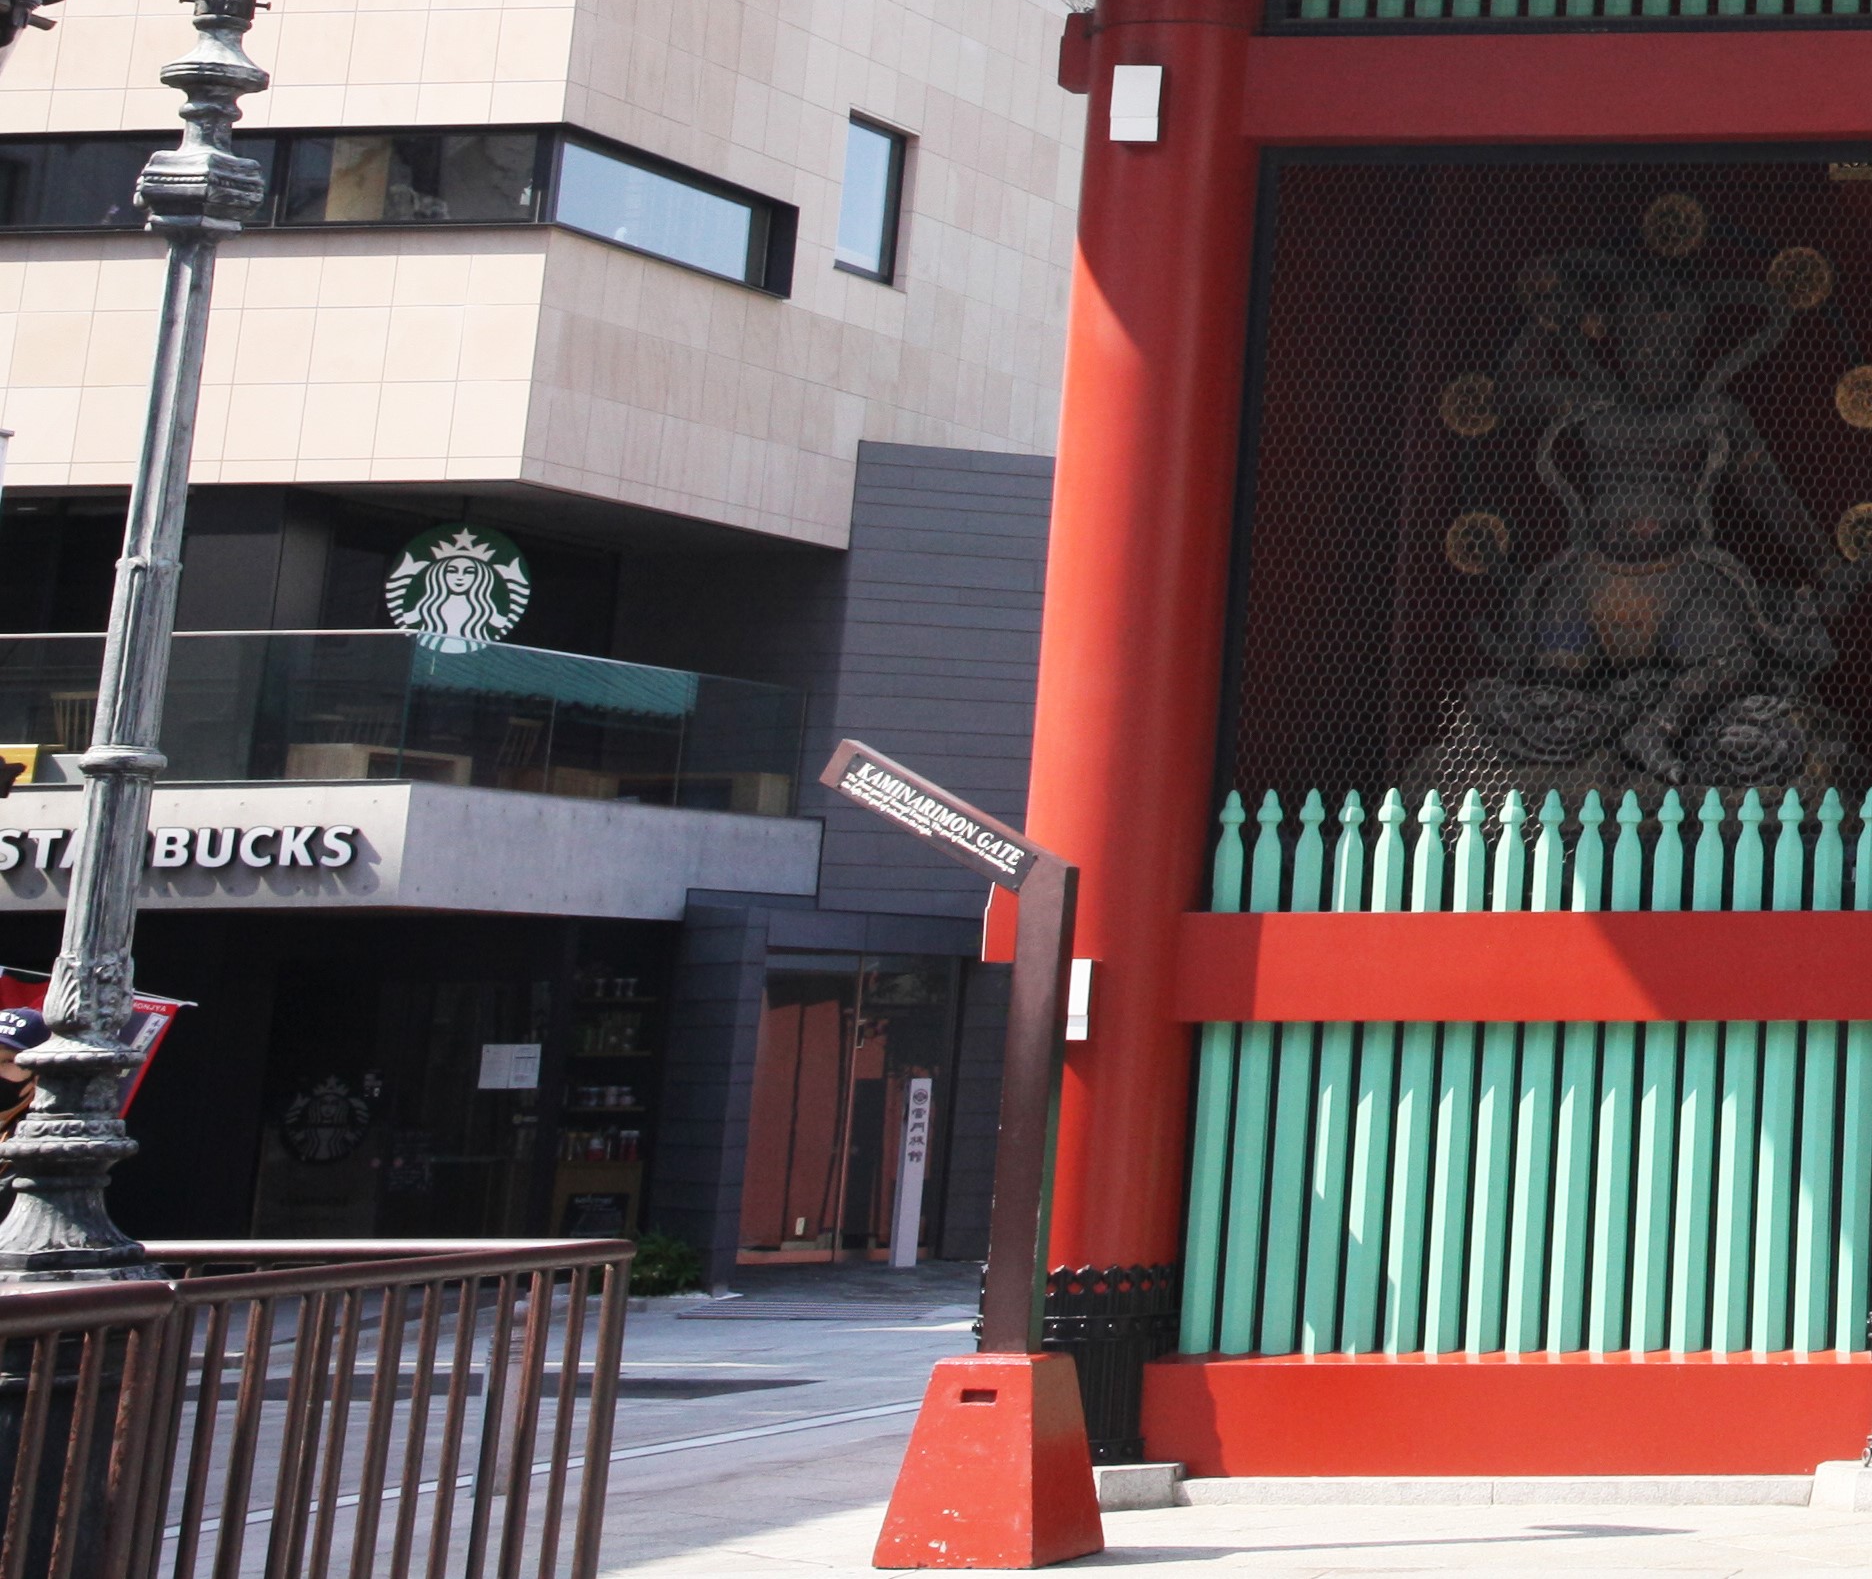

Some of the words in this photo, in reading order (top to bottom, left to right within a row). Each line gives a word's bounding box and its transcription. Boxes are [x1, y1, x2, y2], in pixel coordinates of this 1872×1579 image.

[0, 826, 355, 868] STBUCKS
[857, 762, 980, 840] KAMINARIMON
[976, 831, 1025, 866] GATE
